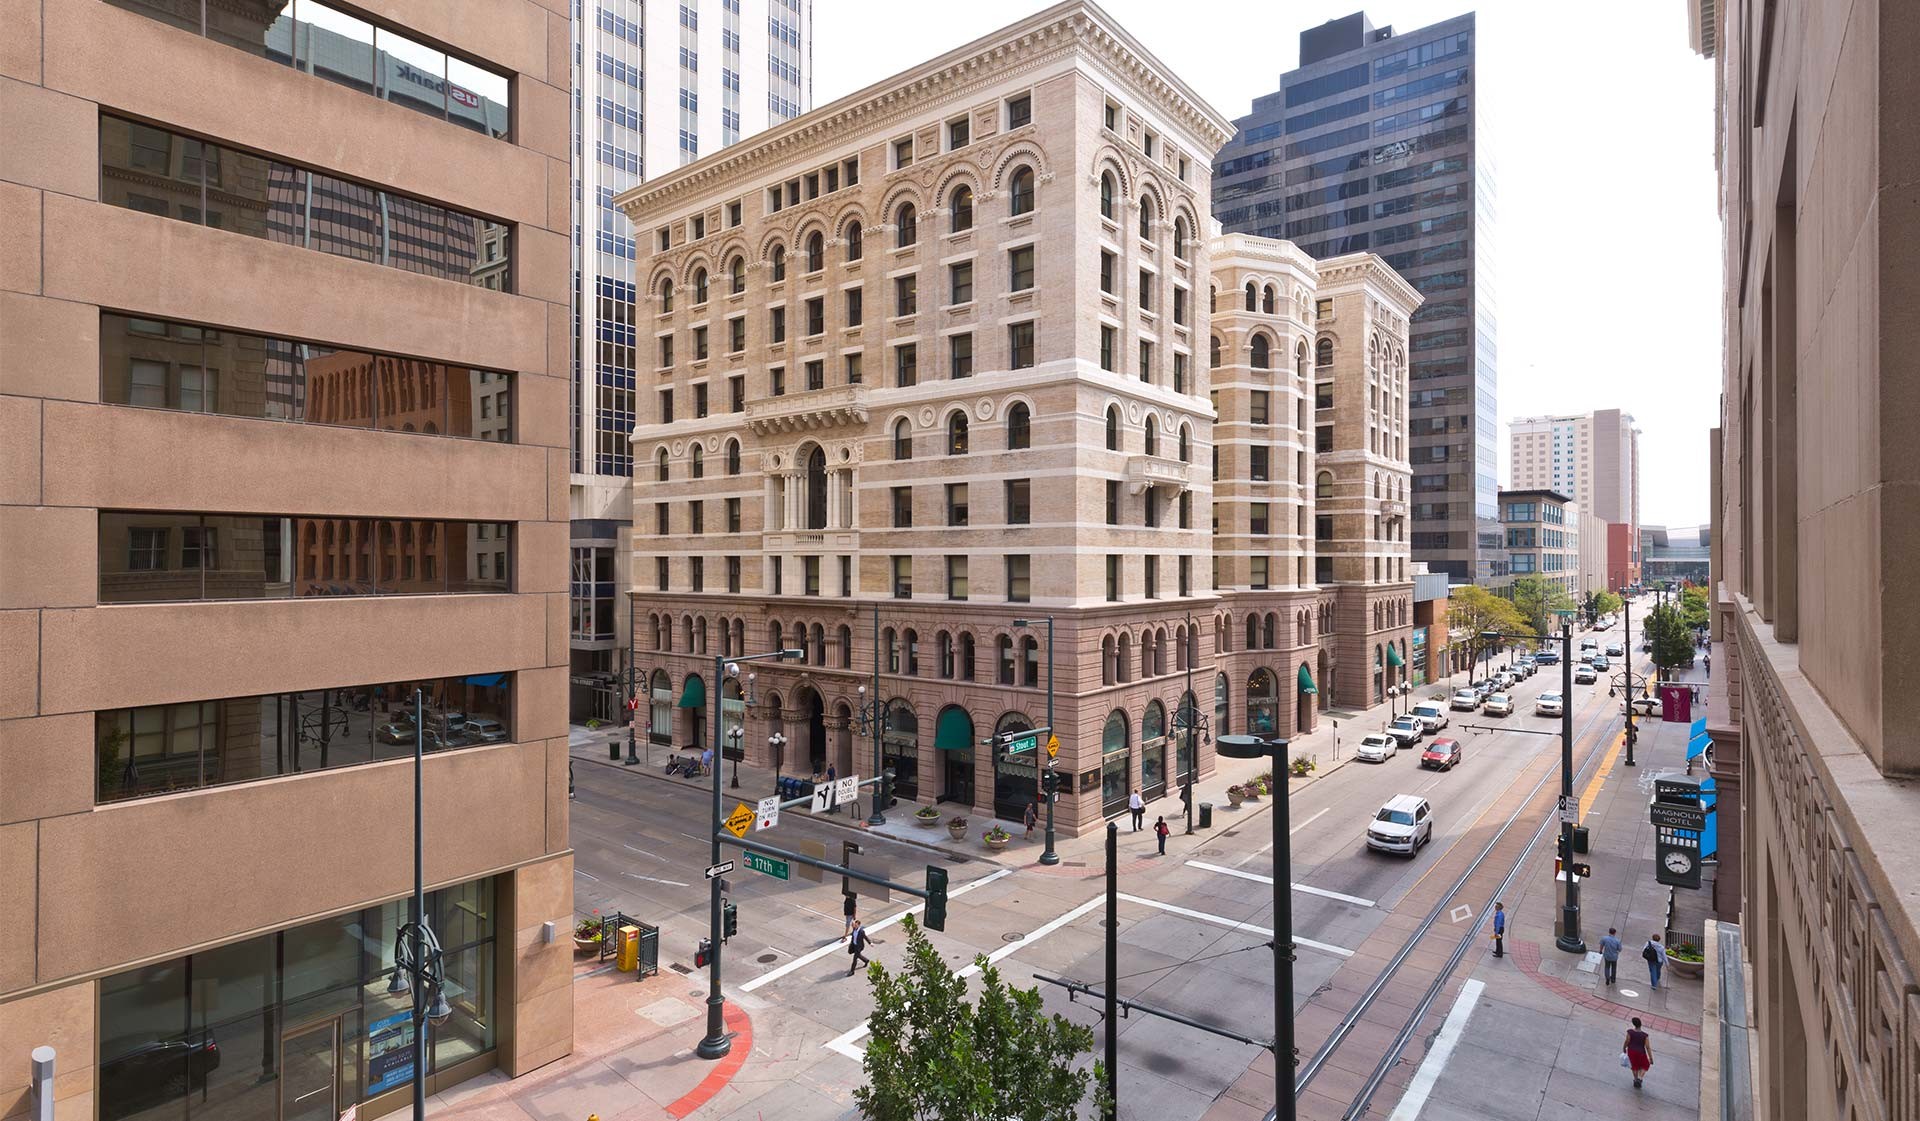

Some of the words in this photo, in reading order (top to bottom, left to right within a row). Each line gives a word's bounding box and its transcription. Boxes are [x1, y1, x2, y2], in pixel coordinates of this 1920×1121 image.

[1015, 740, 1029, 750] Stout
[841, 778, 853, 788] NO
[764, 798, 774, 807] NO
[1652, 808, 1702, 820] MAGNOLIA
[1663, 817, 1693, 826] HOTEL
[755, 857, 773, 873] 17th
